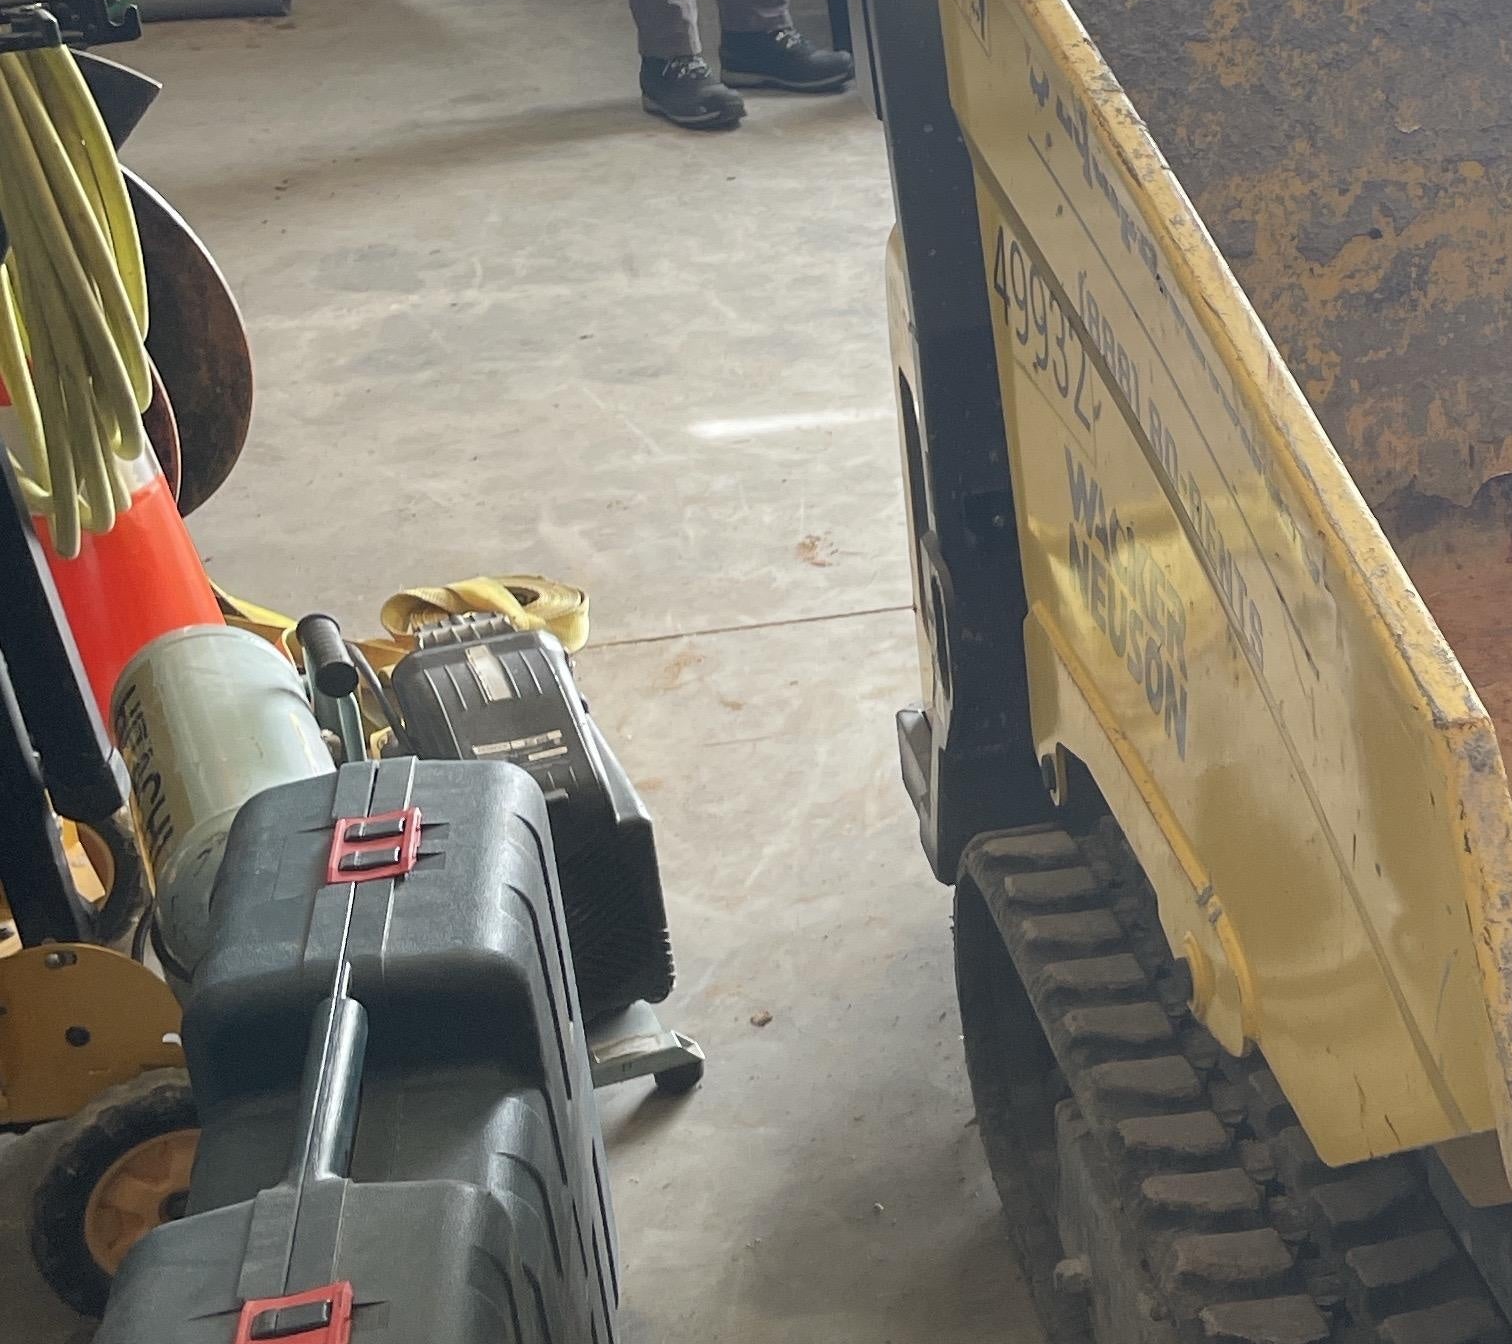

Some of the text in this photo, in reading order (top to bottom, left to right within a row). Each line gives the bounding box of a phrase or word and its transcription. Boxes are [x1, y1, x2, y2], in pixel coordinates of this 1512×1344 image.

[993, 224, 1091, 433] 49932
[1064, 442, 1188, 680] WACKER
[1068, 521, 1189, 762] NEUSON
